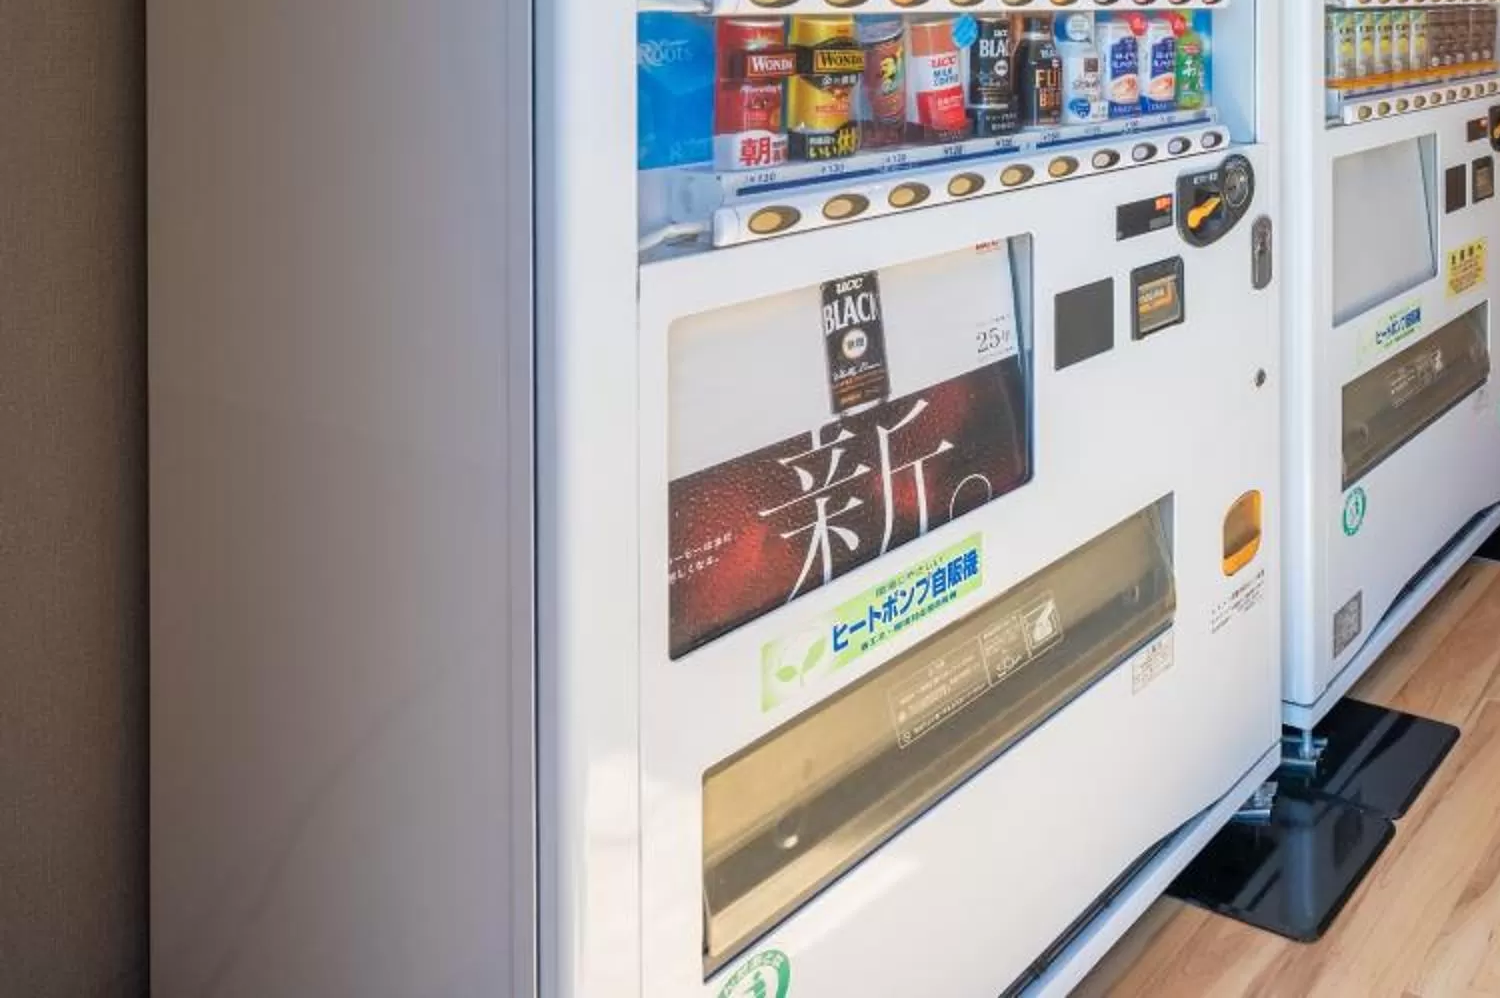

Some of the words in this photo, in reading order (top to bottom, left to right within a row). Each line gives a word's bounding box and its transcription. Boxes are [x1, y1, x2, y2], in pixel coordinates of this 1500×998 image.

[832, 549, 979, 652] ヒートポンプ自販機
